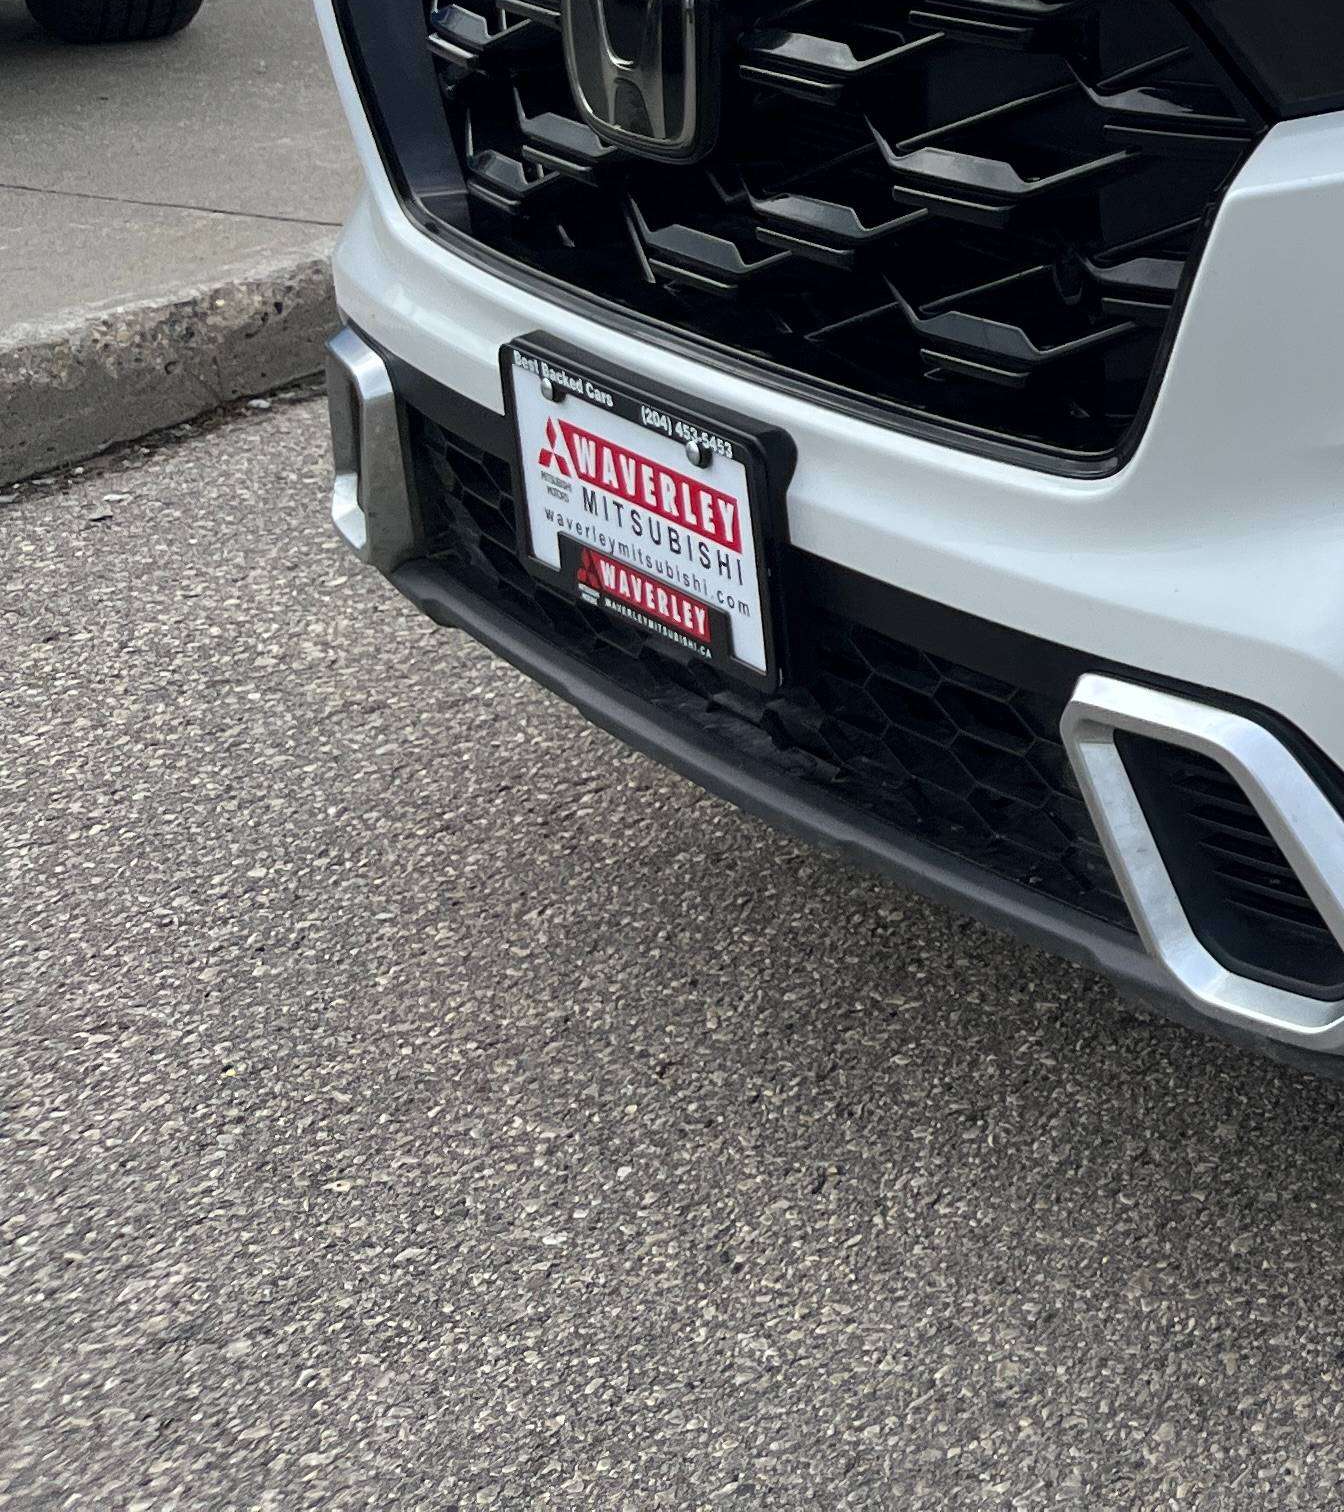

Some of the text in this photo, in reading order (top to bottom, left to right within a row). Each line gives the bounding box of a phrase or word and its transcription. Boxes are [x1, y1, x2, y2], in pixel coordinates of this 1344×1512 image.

[541, 361, 584, 394] Backed
[585, 381, 614, 407] Cars
[641, 405, 733, 459] (204) 453-5453
[572, 432, 736, 543] WAVERLEY
[544, 506, 751, 617] waverleymitsubishi.com
[582, 486, 744, 586] MITSUBISHI
[599, 559, 706, 635] WAVERLEY
